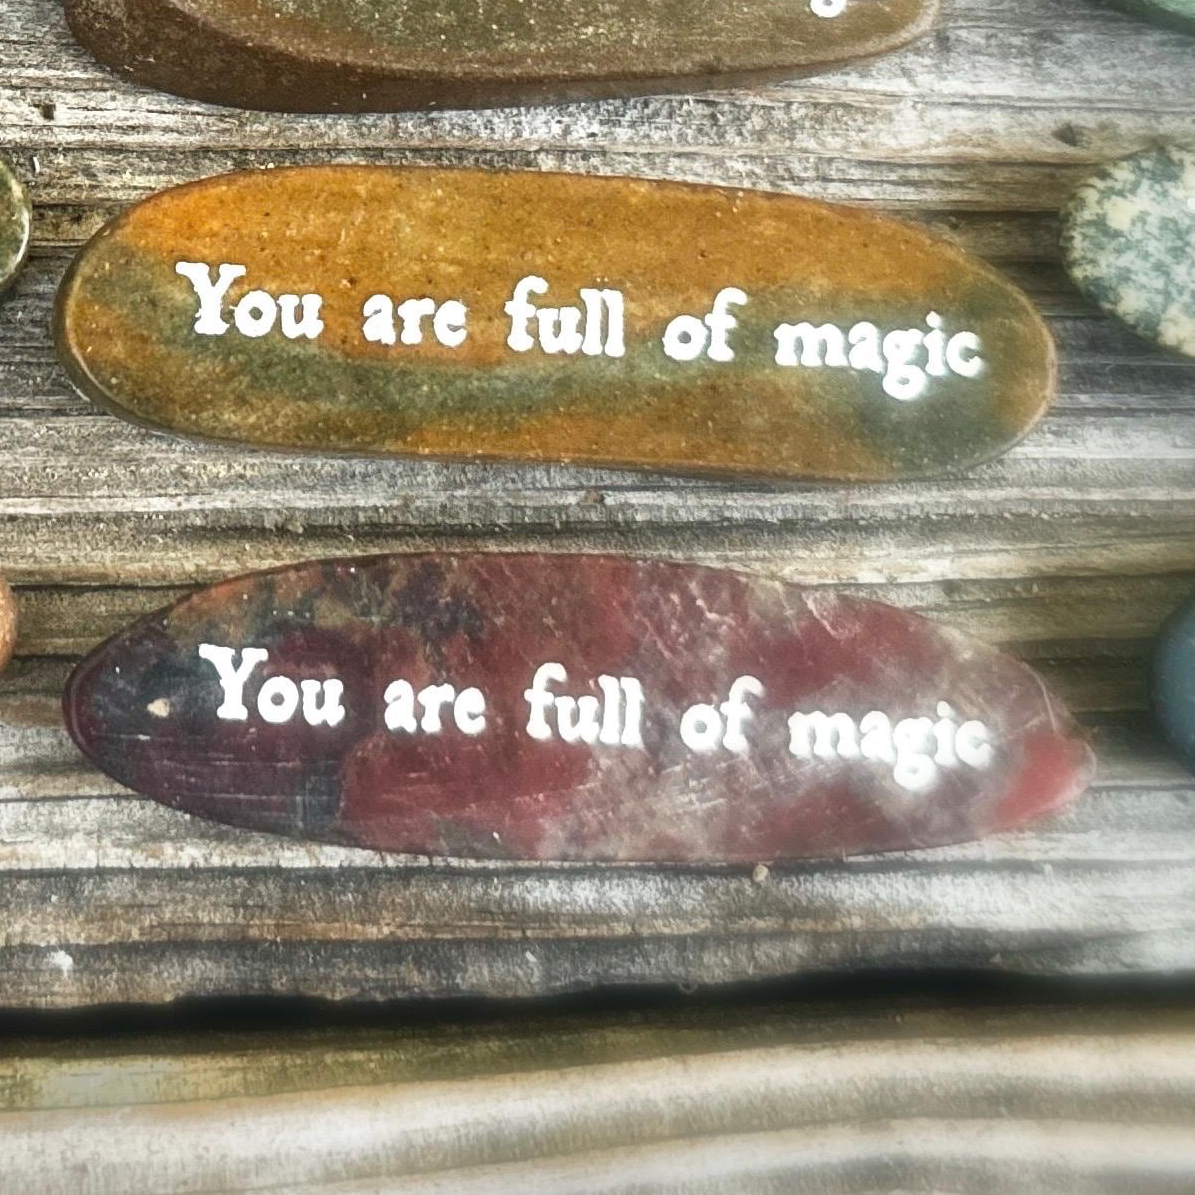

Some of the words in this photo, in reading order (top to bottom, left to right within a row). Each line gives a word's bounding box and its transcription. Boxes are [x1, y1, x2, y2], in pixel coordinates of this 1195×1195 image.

[174, 261, 324, 340] You
[360, 293, 468, 346] are
[505, 277, 625, 357] full
[662, 288, 746, 363] of
[771, 311, 984, 399] magic
[196, 642, 345, 725] You
[383, 677, 486, 734] are
[525, 662, 645, 747] full
[679, 676, 761, 754] of
[787, 702, 994, 791] magic
